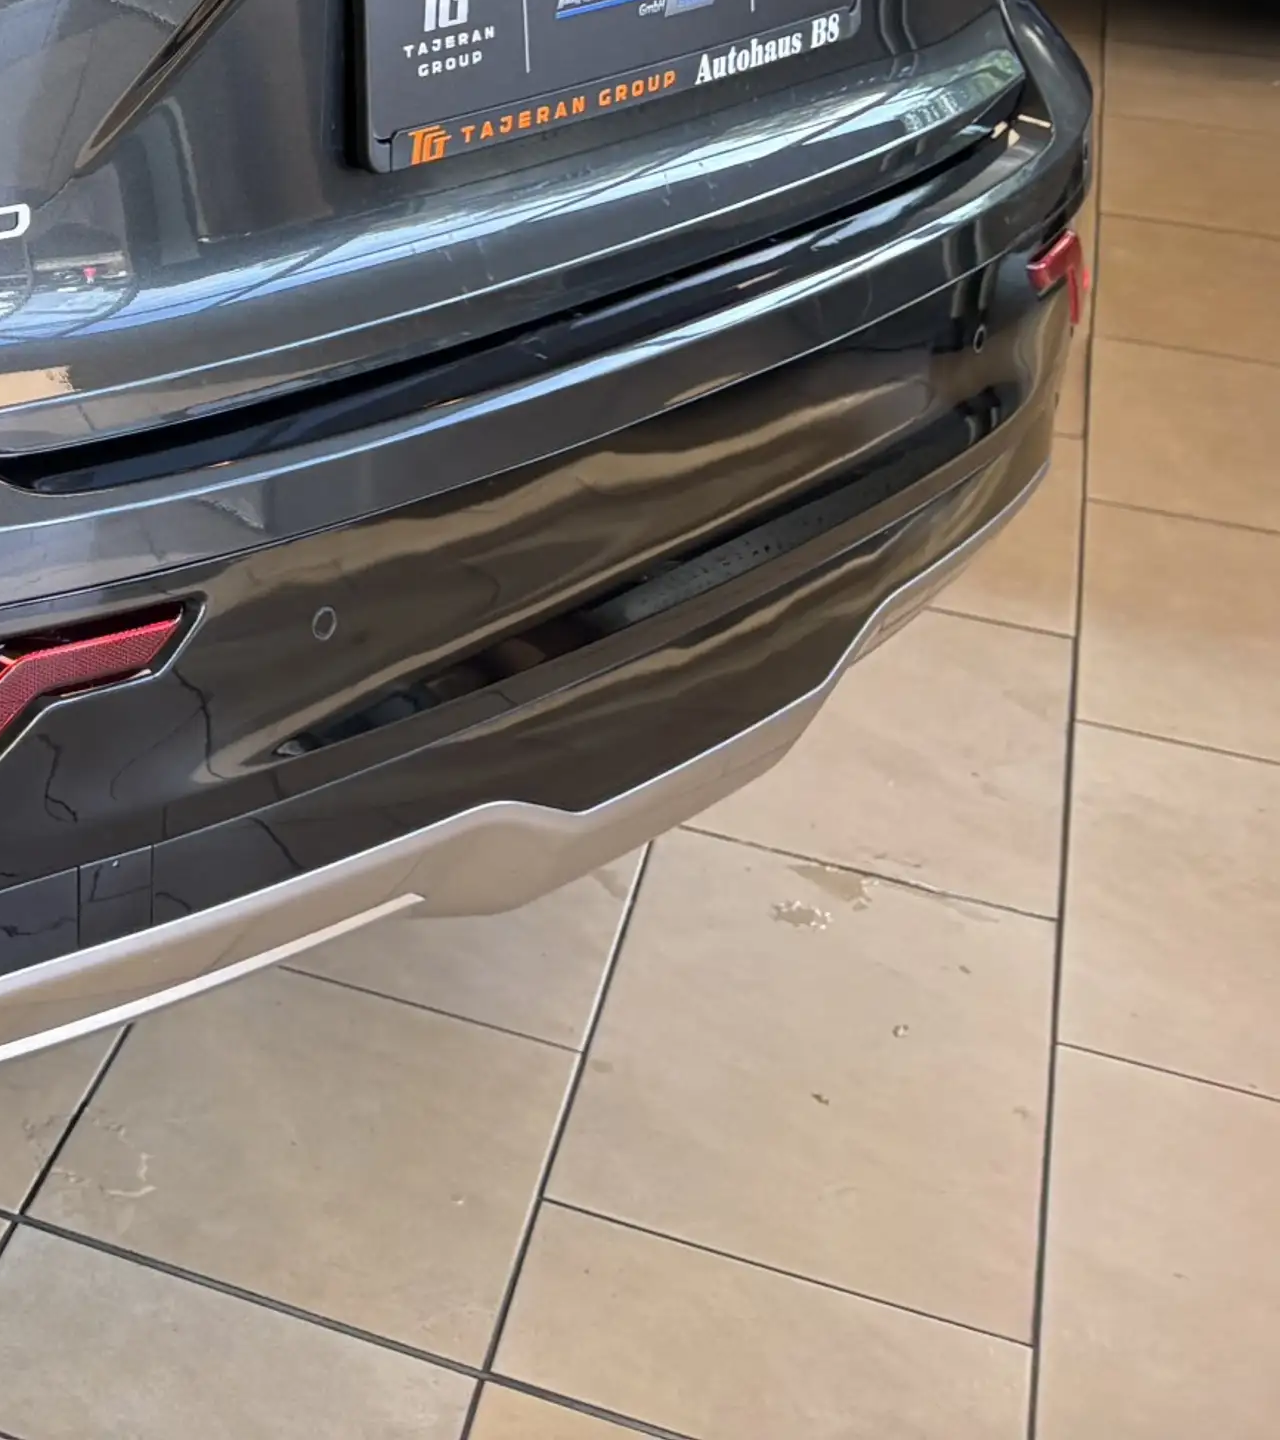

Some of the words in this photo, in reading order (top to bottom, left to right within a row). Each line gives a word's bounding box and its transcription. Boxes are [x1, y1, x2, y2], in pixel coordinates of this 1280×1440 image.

[403, 26, 495, 58] TAJERAN
[417, 50, 483, 77] GROUP
[695, 32, 802, 85] Autohaus
[811, 13, 840, 48] B8
[461, 96, 586, 143] TAJERAN
[598, 70, 676, 107] GROUP
